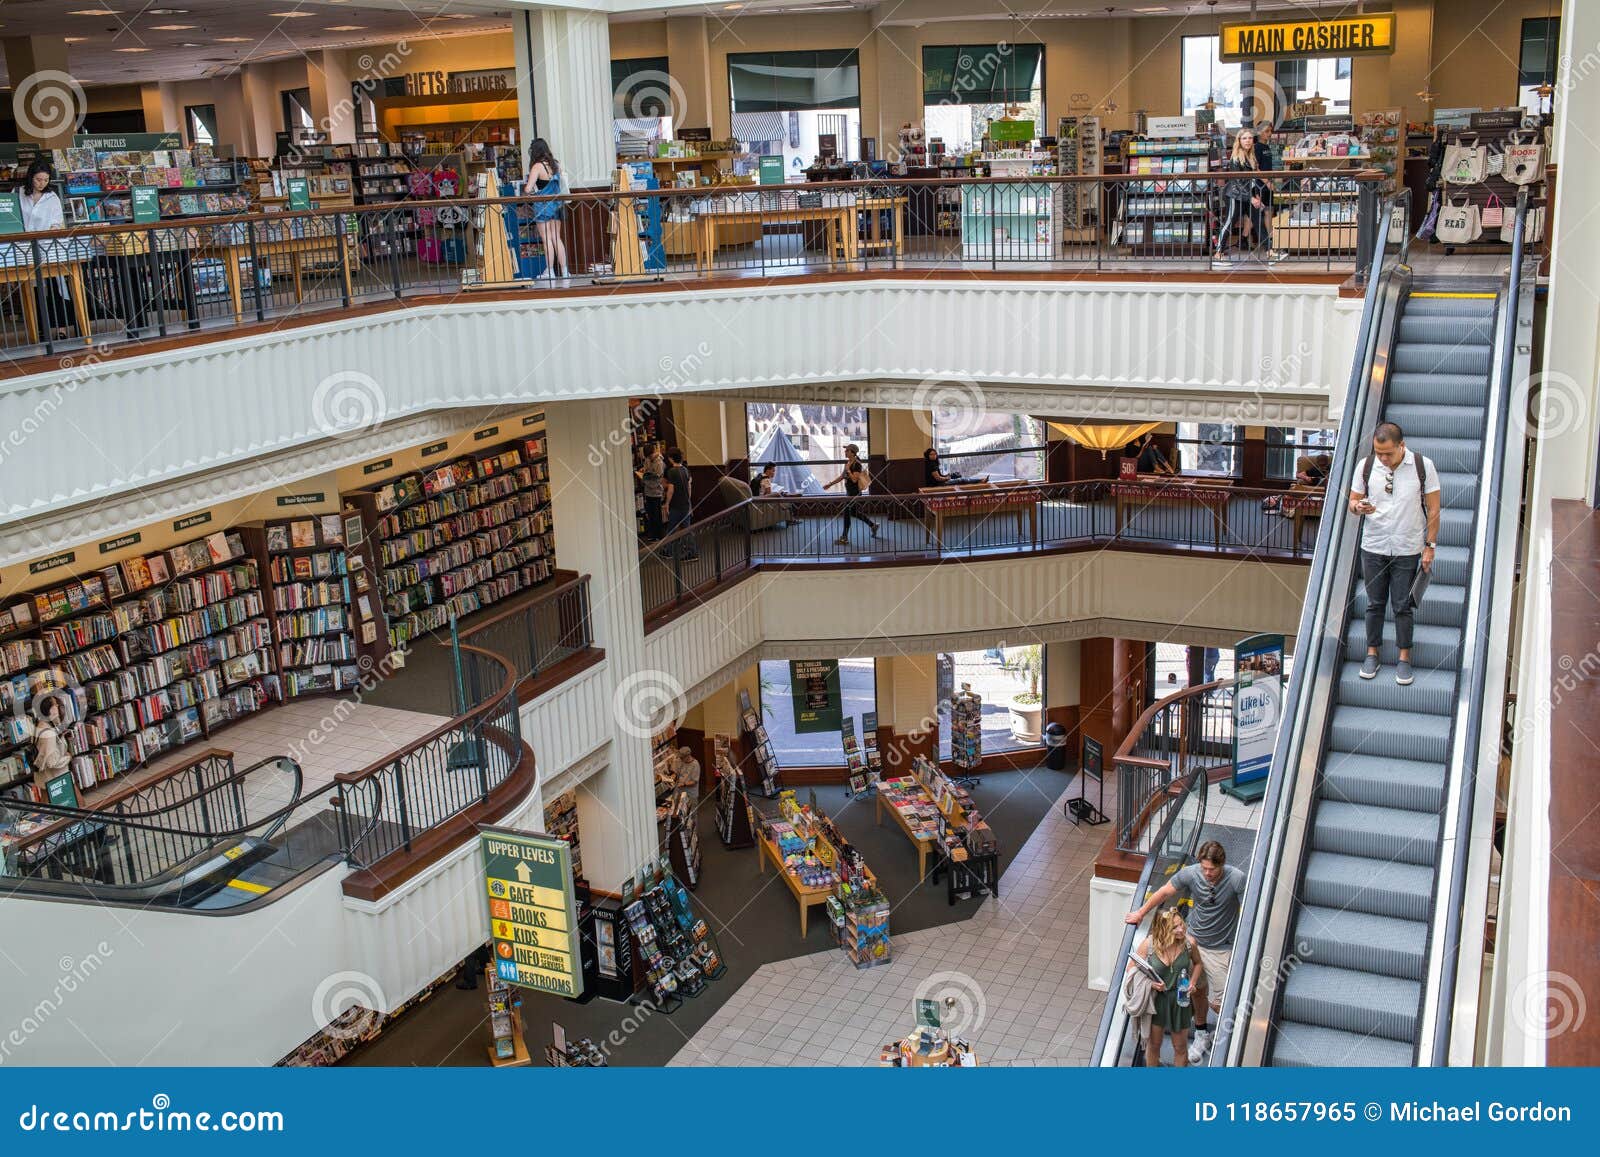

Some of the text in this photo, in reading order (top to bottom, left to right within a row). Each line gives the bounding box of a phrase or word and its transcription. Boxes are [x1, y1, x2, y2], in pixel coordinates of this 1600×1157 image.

[1238, 23, 1375, 54] MAIN CASHIER
[405, 71, 446, 96] GIFTS
[465, 74, 507, 92] READERS
[82, 138, 126, 148] JIGSAW PUZZLES
[1445, 219, 1465, 229] READ
[1240, 693, 1271, 711] Like Us
[488, 841, 555, 865] UPPER LEVELS
[511, 906, 547, 927] BOOKS
[513, 927, 539, 946] KIDS
[516, 948, 564, 966] INFO CUSTOMER
[541, 960, 565, 971] SERVICES
[518, 970, 571, 993] RESTROOMS
